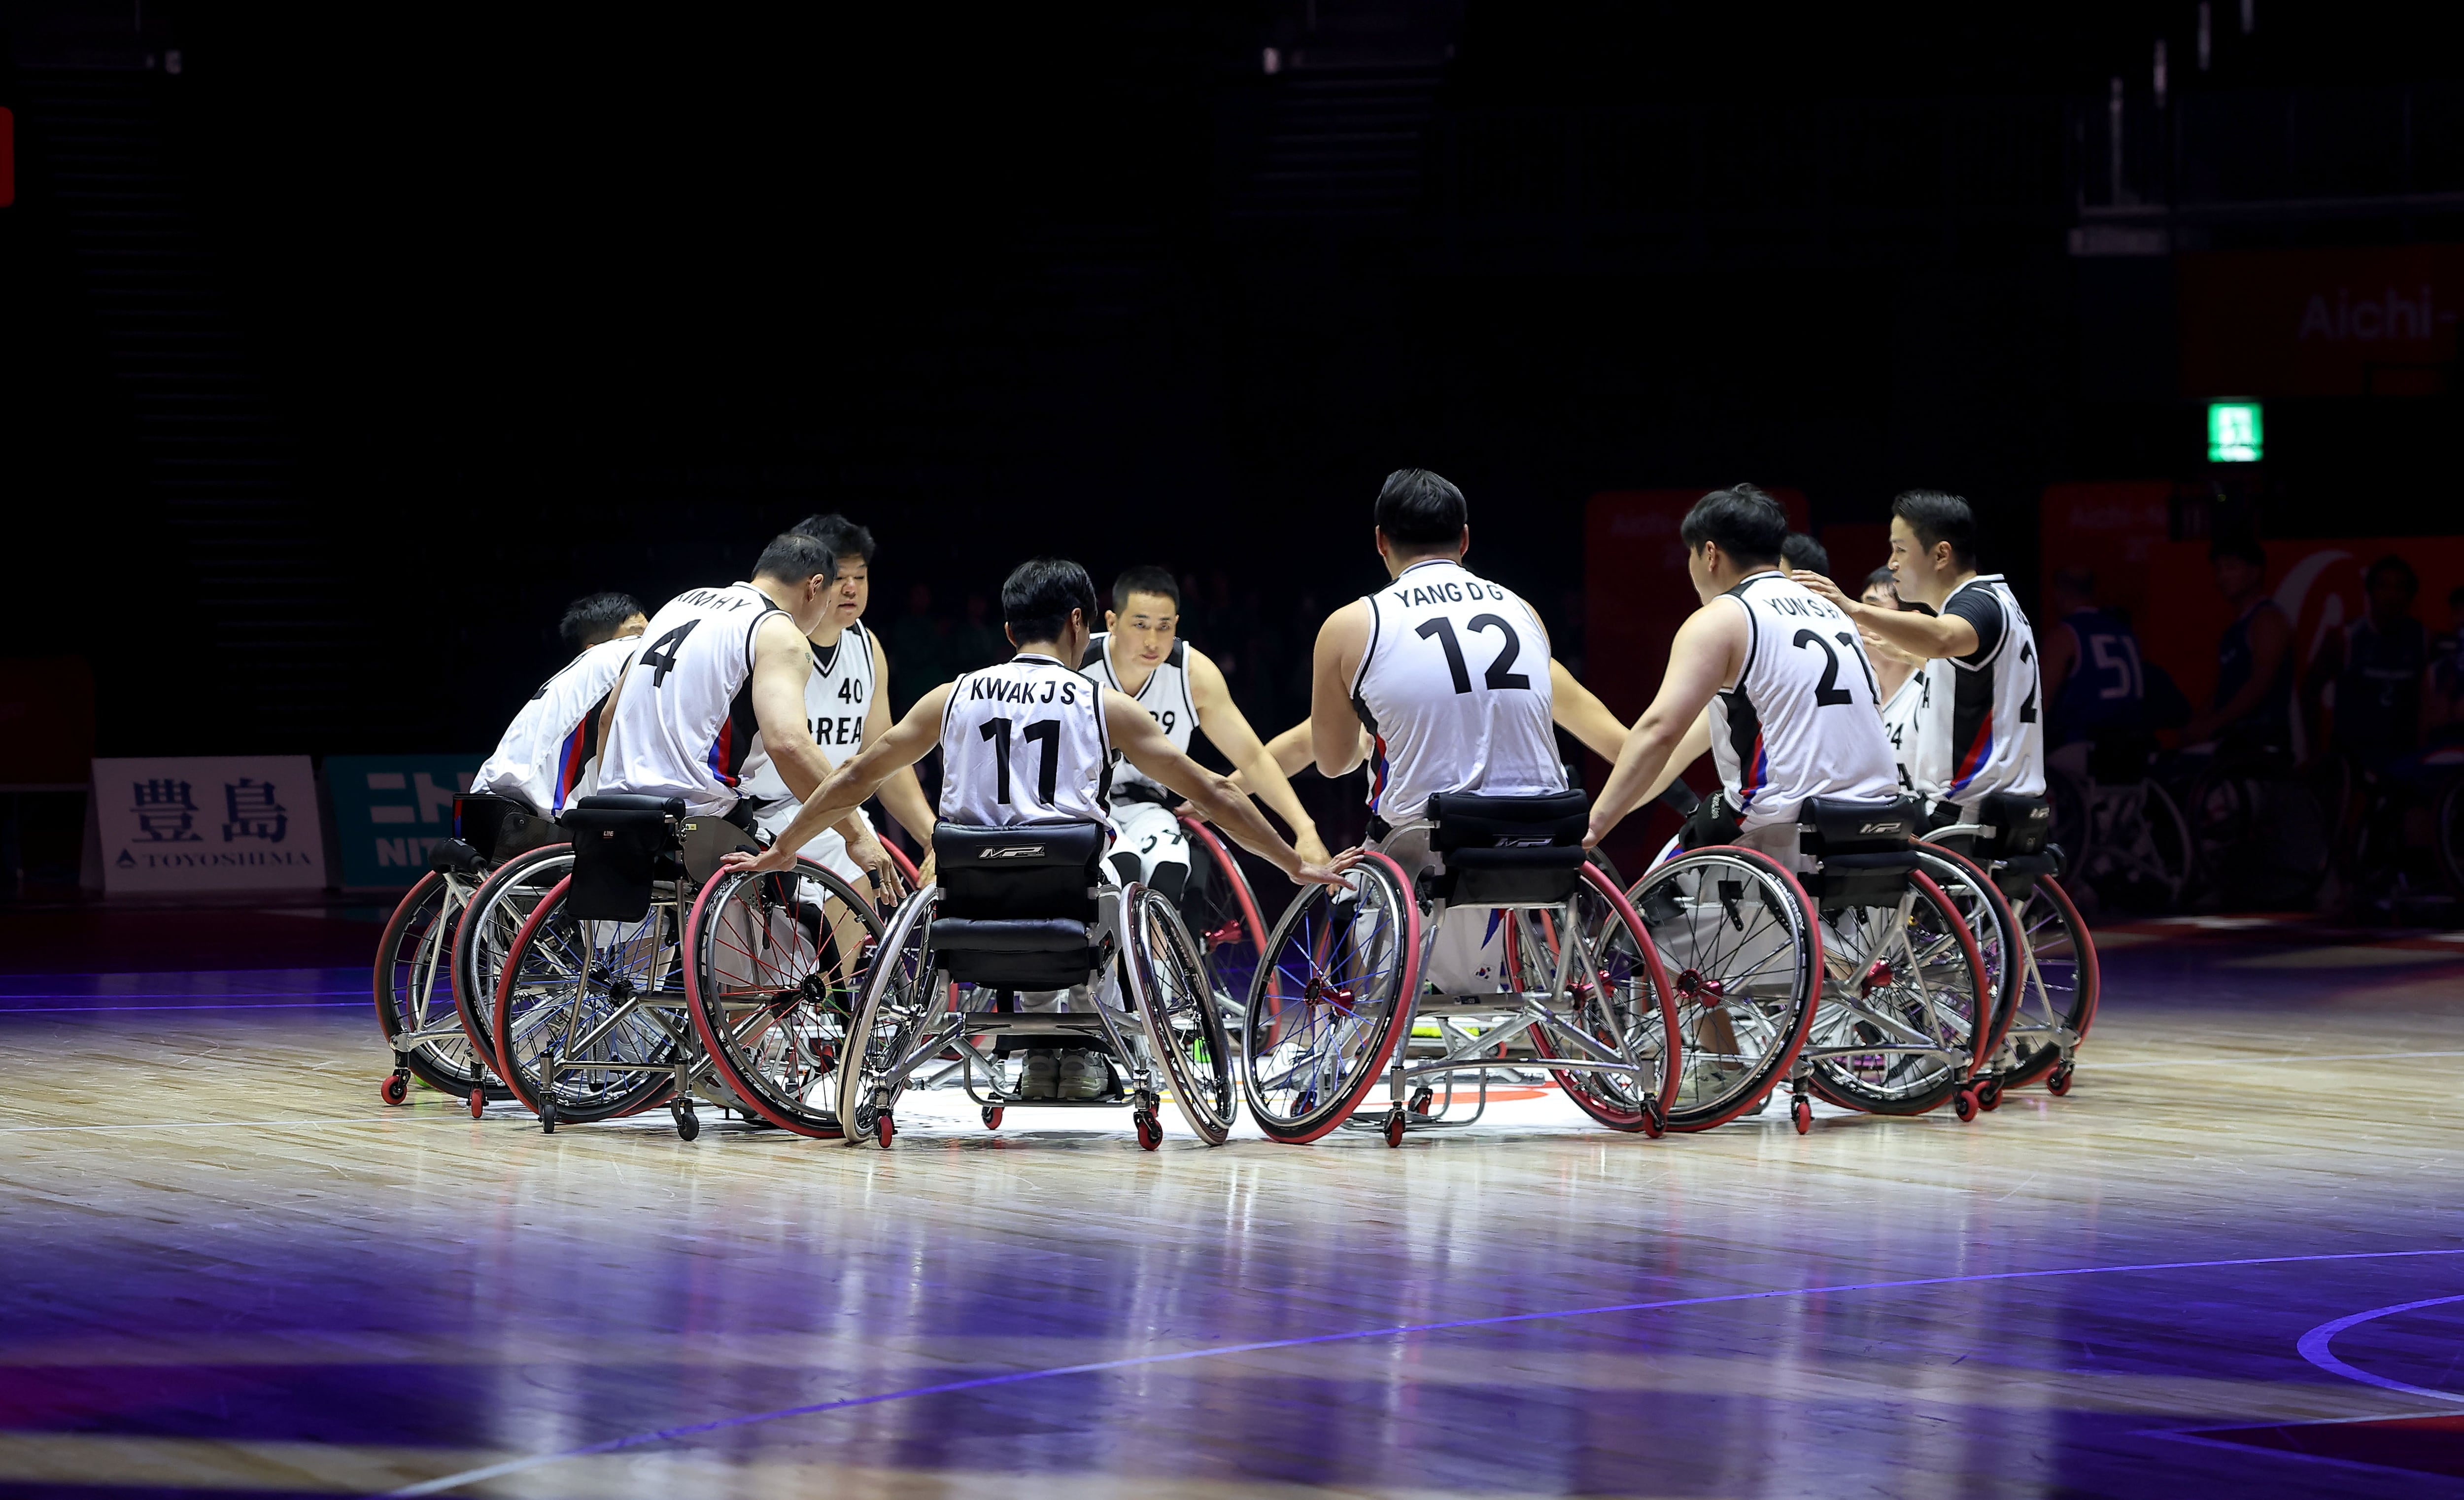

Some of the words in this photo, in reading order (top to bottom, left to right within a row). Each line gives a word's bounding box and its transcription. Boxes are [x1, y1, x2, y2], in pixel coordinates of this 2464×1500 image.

[1394, 583, 1463, 607] YANG
[1763, 597, 1811, 617] YUN
[640, 619, 701, 688] 4
[1414, 613, 1531, 694] 12
[1793, 629, 1880, 706] 21
[2088, 633, 2145, 700] 51
[838, 678, 862, 704] 40
[970, 677, 1037, 704] KWAK
[808, 716, 861, 745] REA
[979, 717, 1061, 807] 11
[142, 852, 311, 868] TOYOSHIMA
